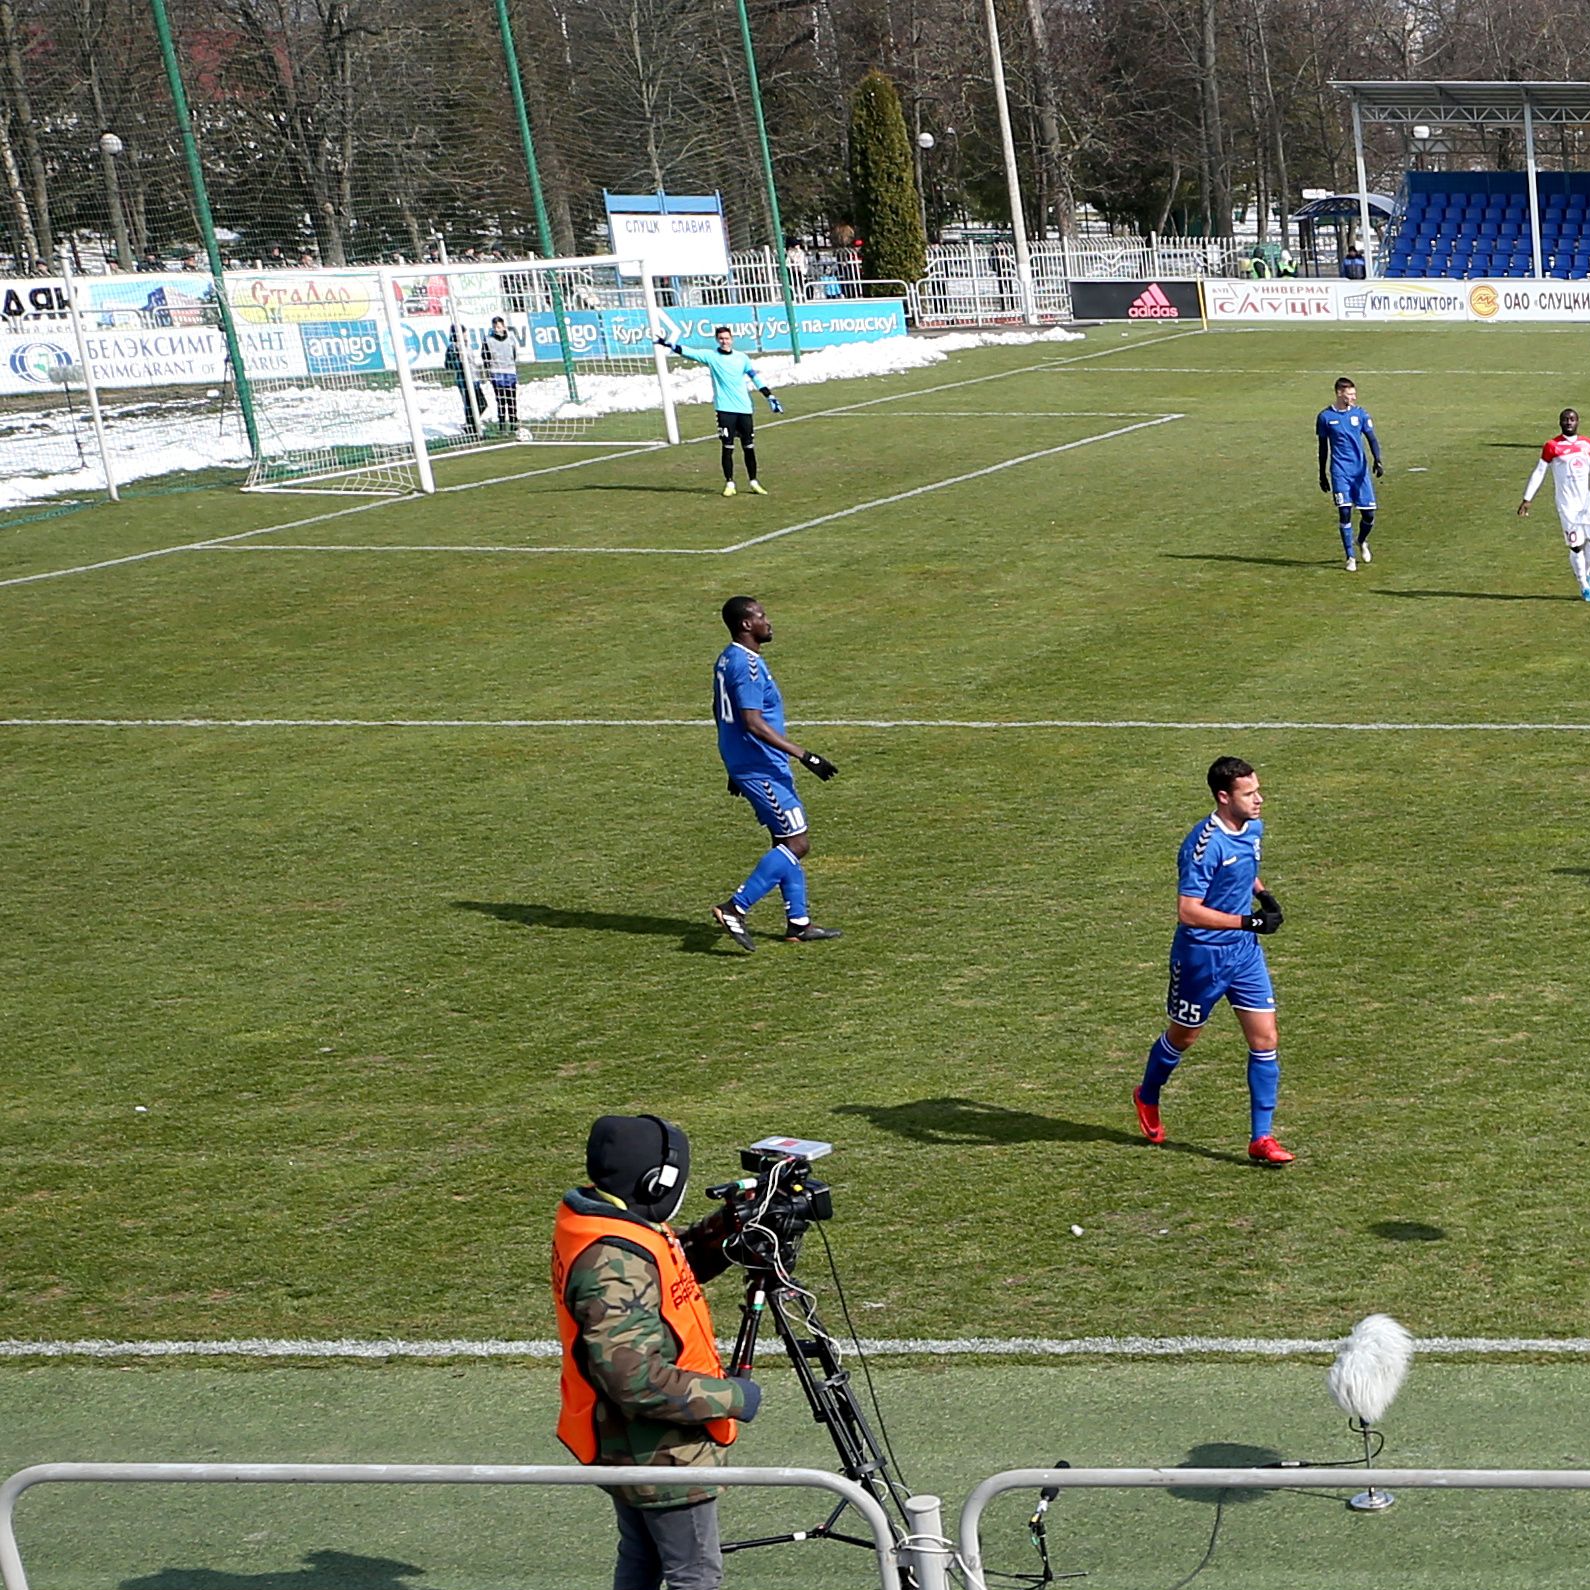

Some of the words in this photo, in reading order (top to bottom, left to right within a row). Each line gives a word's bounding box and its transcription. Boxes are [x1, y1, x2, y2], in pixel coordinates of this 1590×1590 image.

[626, 219, 660, 233] СЛУЦК
[671, 219, 712, 233] СЛАВИЯ
[1252, 286, 1332, 295] УНИВЕРМАГ
[1128, 305, 1179, 318] adidas
[1213, 294, 1332, 316] СЛУЦК
[1370, 295, 1390, 311] КУП
[1393, 295, 1465, 313] «СЛУЦКТОРГ»
[1504, 293, 1530, 310] ОАО
[679, 320, 693, 338] У
[697, 319, 764, 339] Слцку
[767, 317, 799, 339] ўс
[802, 313, 898, 337] па-людску!
[87, 330, 285, 360] БЕЛЭКСИМГААНТ
[309, 328, 376, 360] amigo
[92, 360, 195, 380] EXIMGARANT
[1178, 999, 1201, 1023] 25
